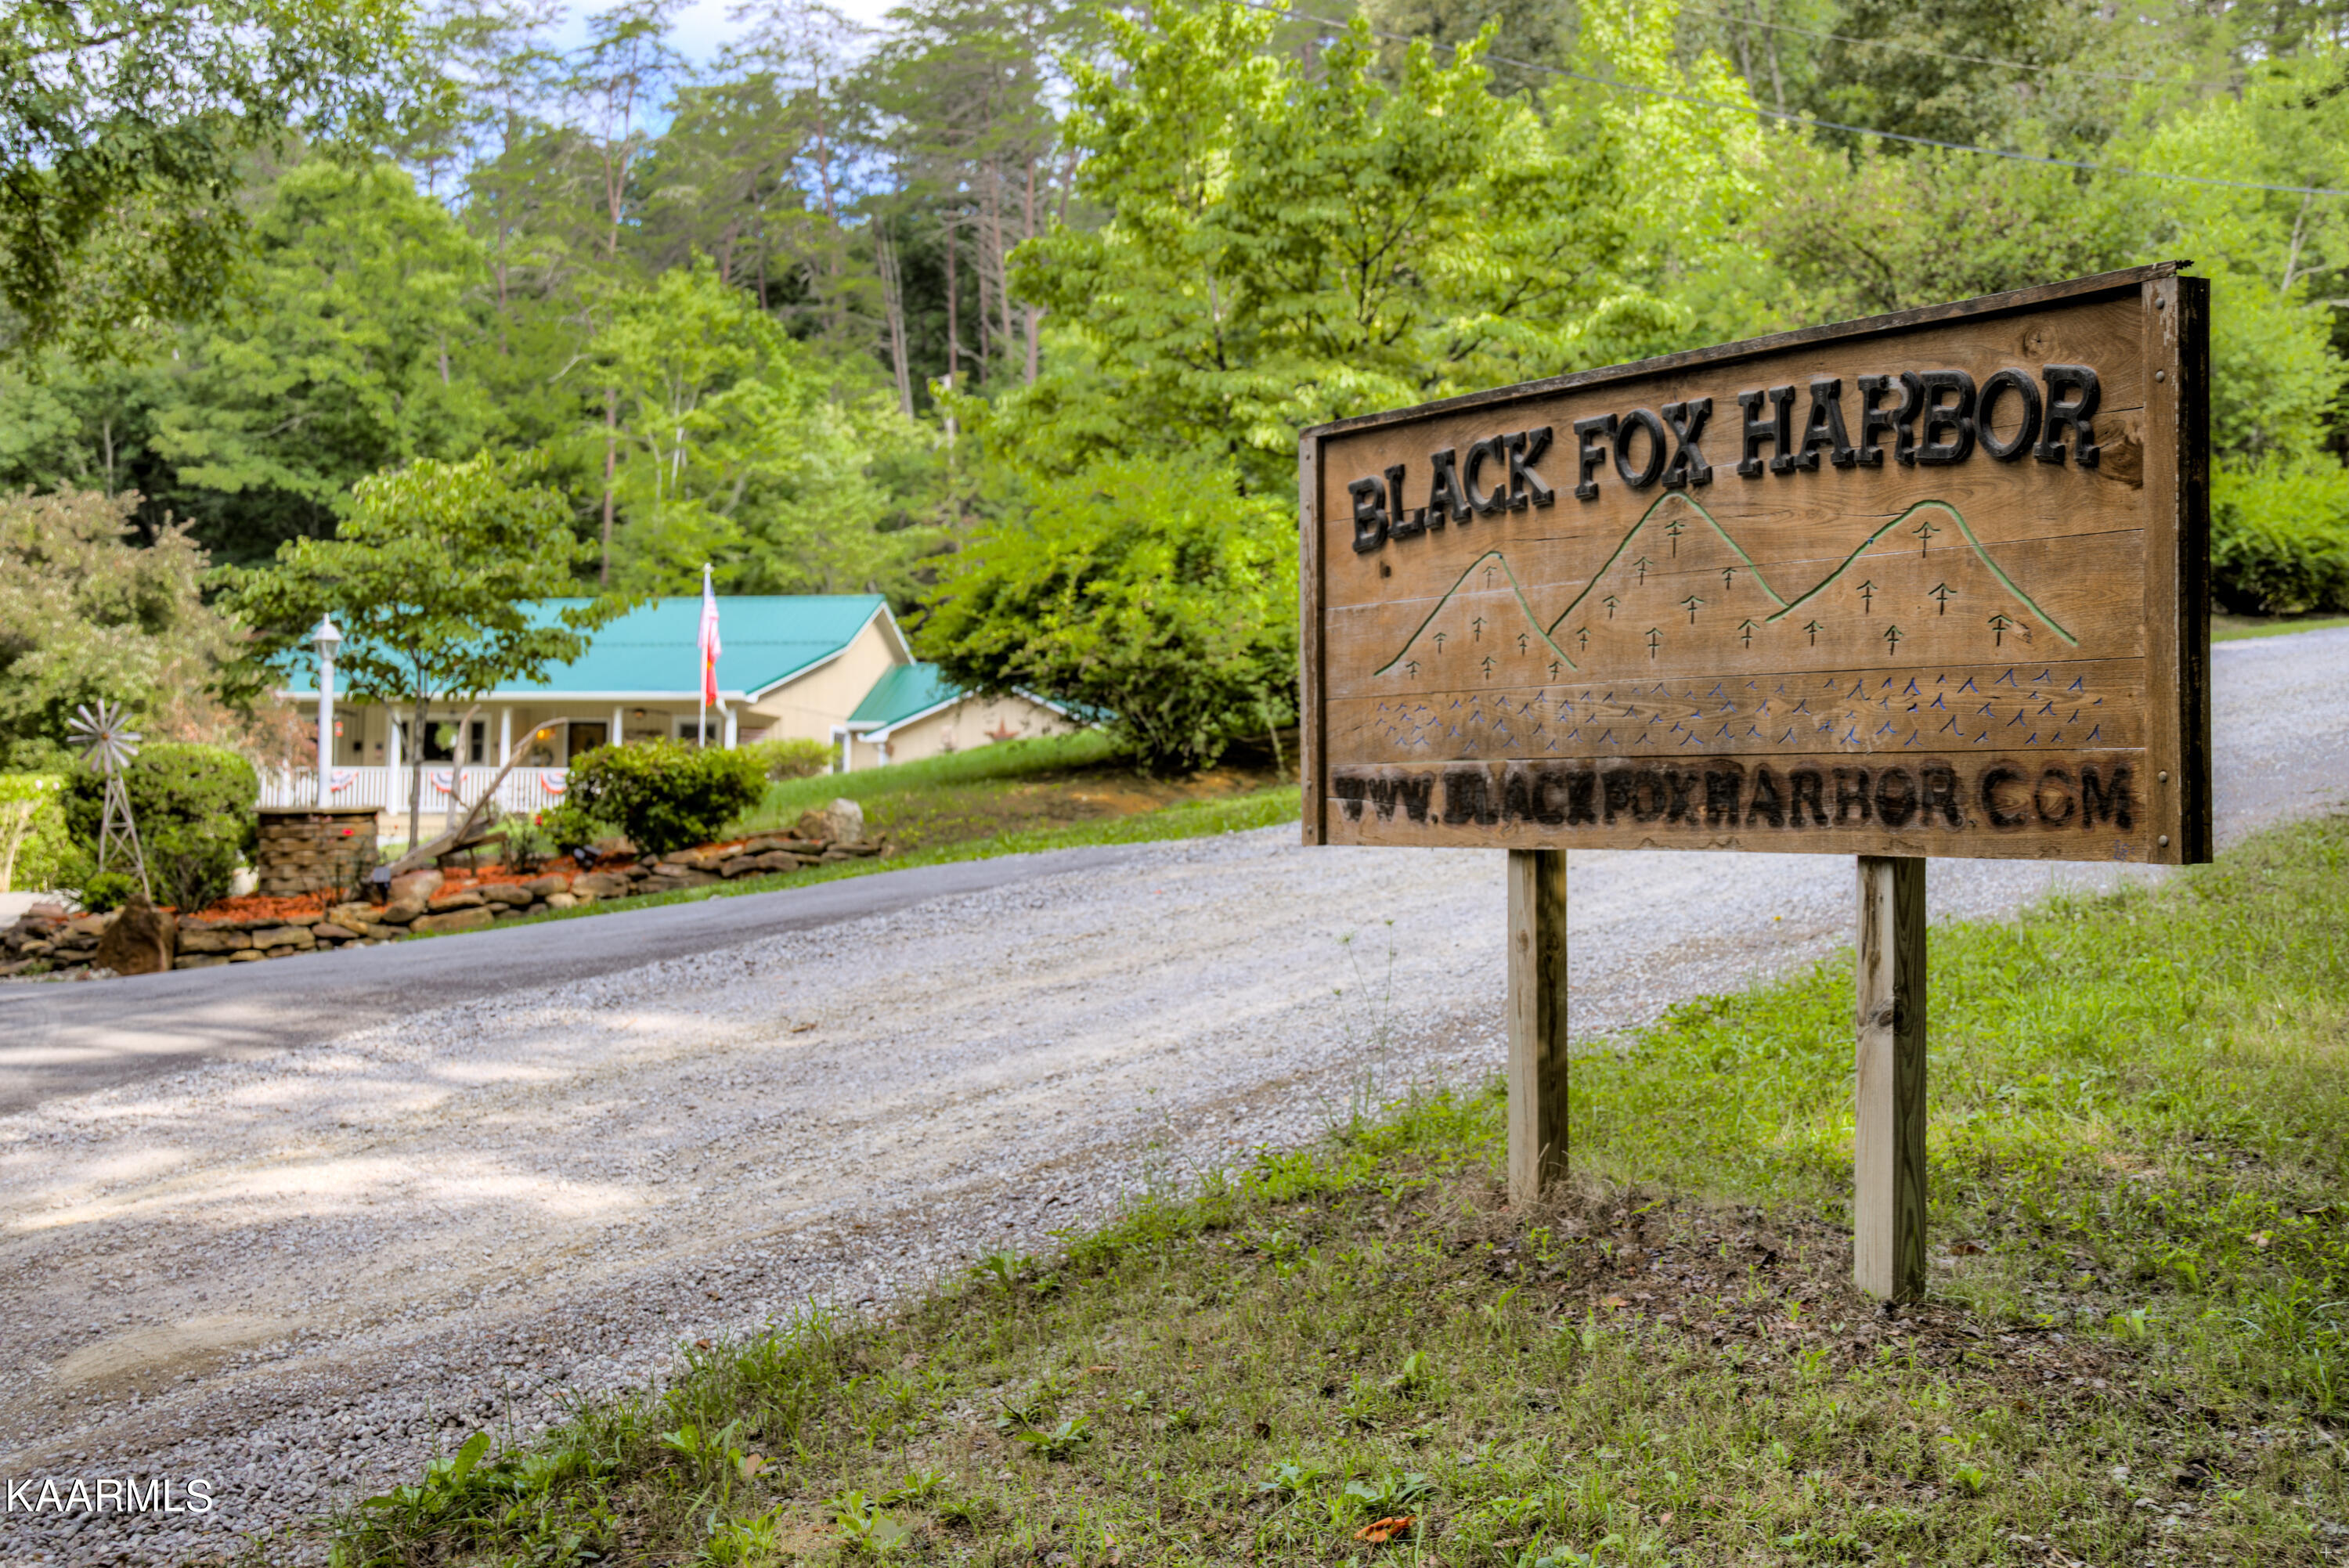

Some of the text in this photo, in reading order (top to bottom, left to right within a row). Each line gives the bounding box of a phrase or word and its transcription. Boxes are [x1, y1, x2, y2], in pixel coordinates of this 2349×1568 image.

[1348, 363, 2102, 553] BLACK FOX HARBOR
